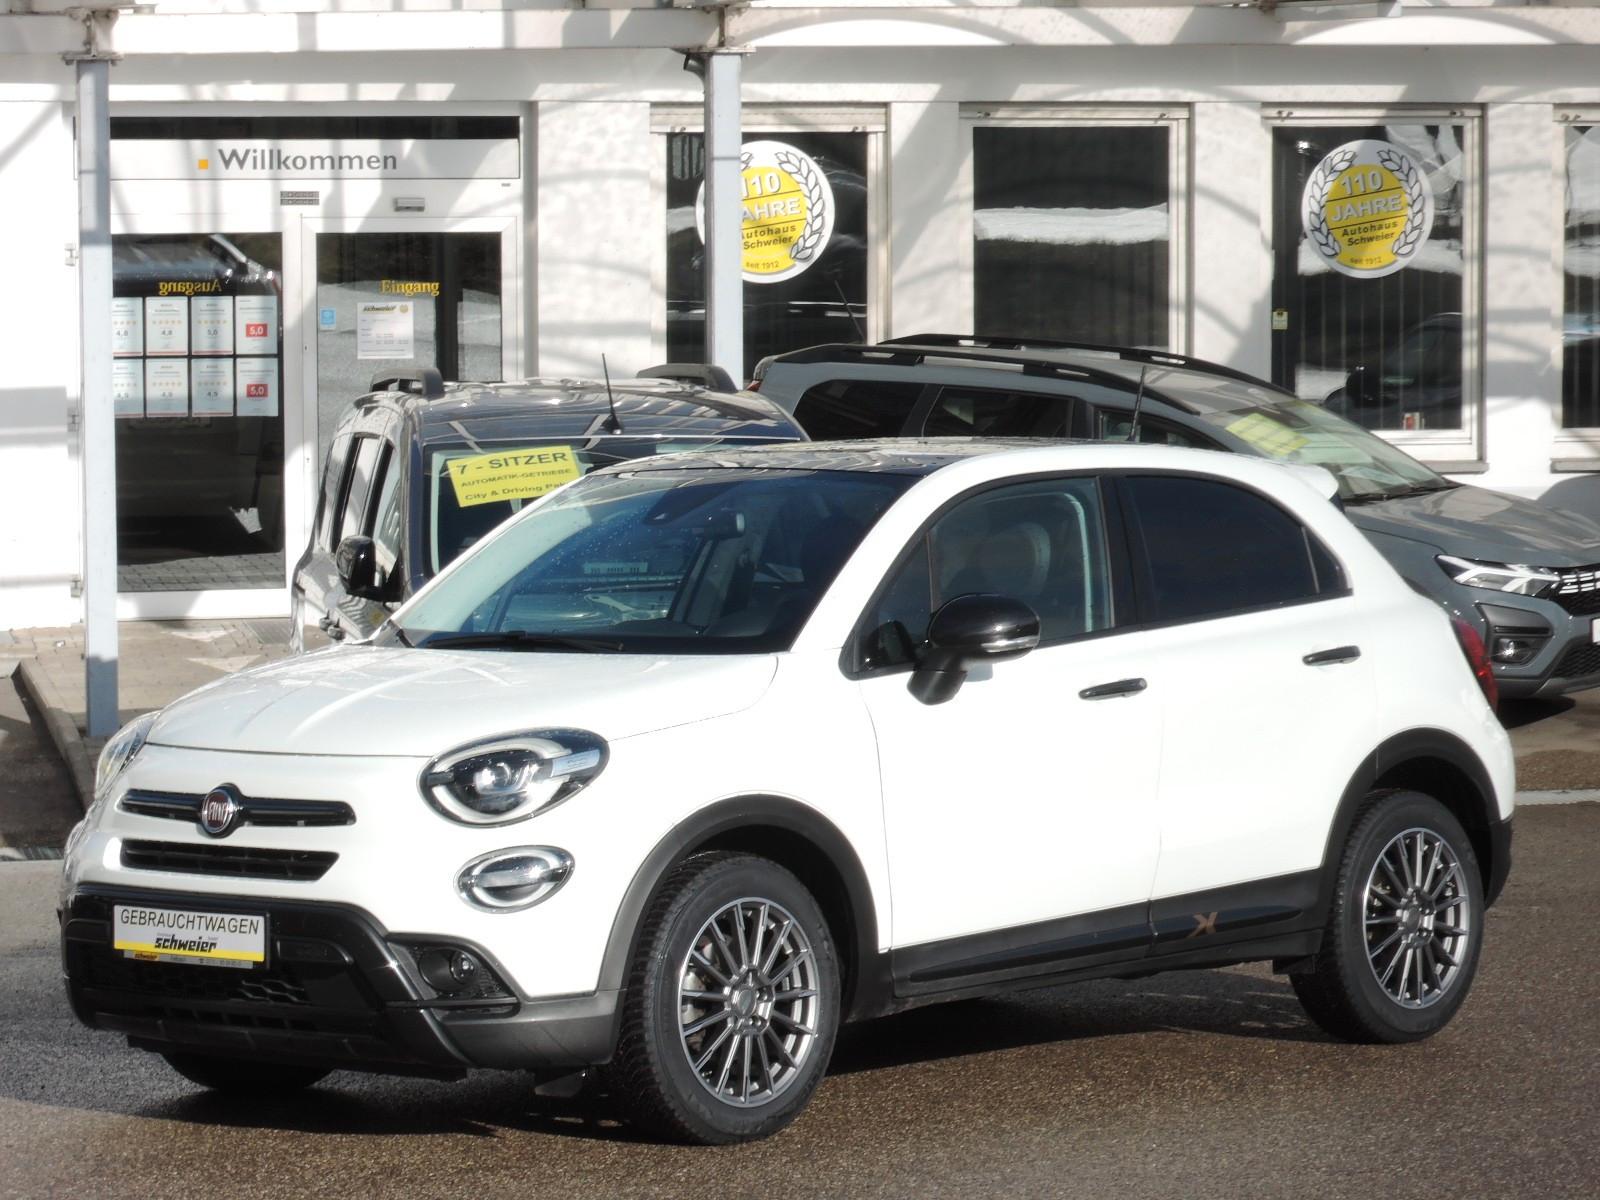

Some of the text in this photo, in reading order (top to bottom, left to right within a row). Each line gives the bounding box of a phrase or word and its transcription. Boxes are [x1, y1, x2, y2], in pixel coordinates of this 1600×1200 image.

[217, 148, 397, 170] Willkommen
[1341, 170, 1383, 195] 110
[742, 198, 801, 223] AHRE
[1331, 193, 1403, 222] JAHRE
[742, 224, 797, 240] utohaus
[1342, 221, 1398, 237] Autohaus
[743, 235, 793, 250] Schweier
[1347, 232, 1395, 247] Schweier
[761, 260, 779, 269] 1912
[381, 280, 440, 296] Eingang
[249, 326, 264, 336] 5,0
[250, 386, 265, 397] 5,0
[456, 463, 468, 476] 7
[489, 452, 568, 470] SITZER
[461, 468, 572, 487] AUTOMATIK-GETRIEBE
[465, 491, 487, 502] City
[490, 488, 500, 496] &
[502, 485, 543, 494] Driving
[120, 908, 260, 935] GEBRAUCHTWAGEN
[154, 934, 218, 953] schweier
